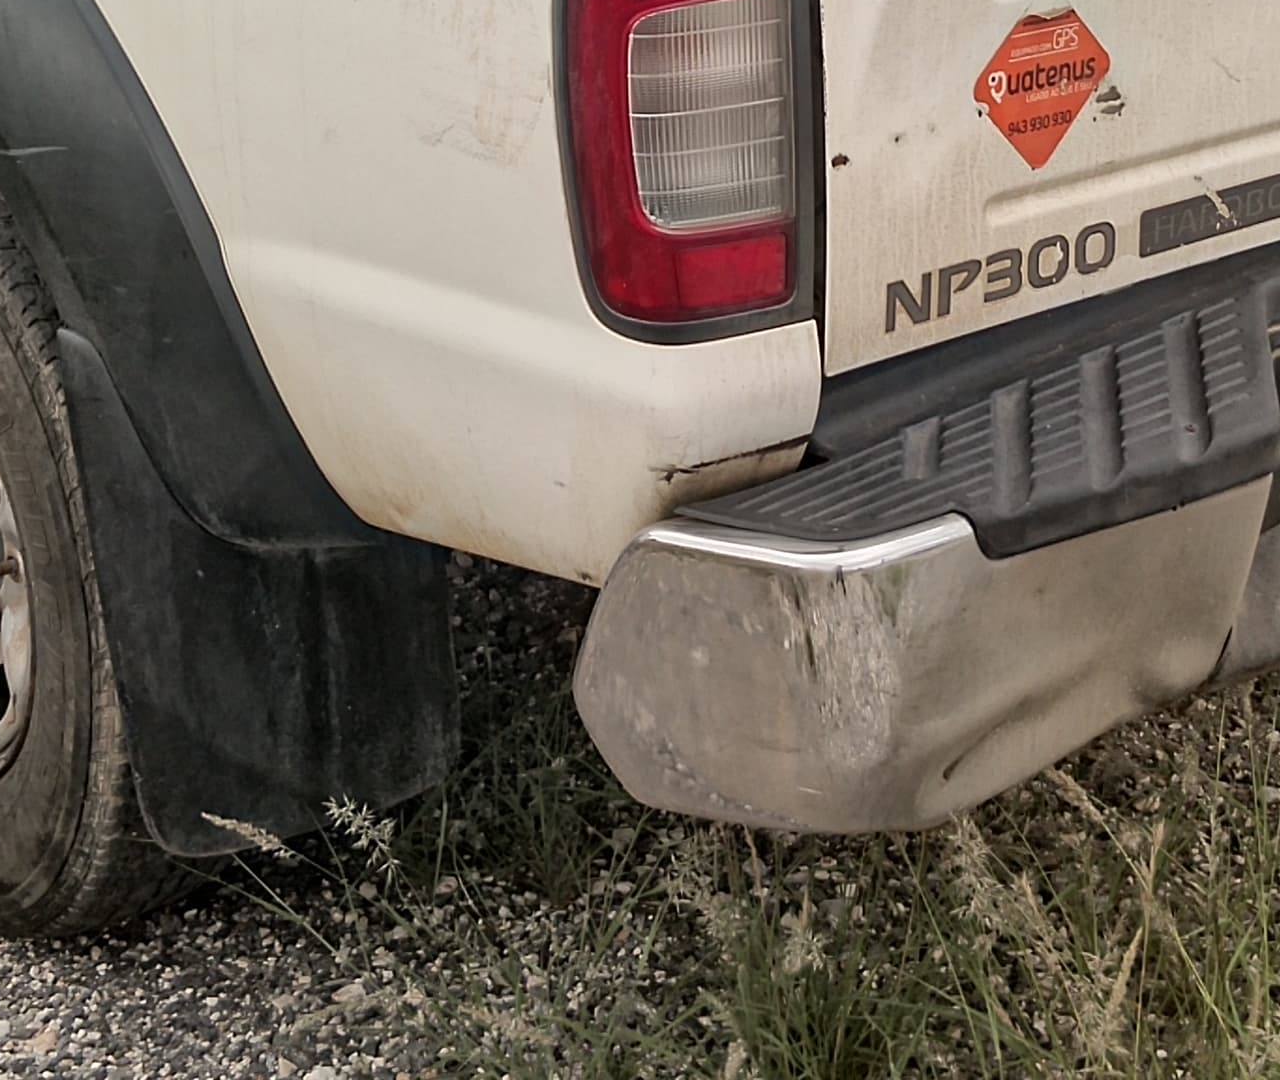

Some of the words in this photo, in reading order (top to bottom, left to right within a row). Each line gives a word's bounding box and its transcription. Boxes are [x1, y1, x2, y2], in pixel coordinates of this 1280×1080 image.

[1053, 27, 1080, 50] GPS
[1008, 119, 1029, 137] 943
[1029, 115, 1050, 133] 930
[1051, 110, 1072, 126] 930
[884, 221, 1116, 334] NP300
